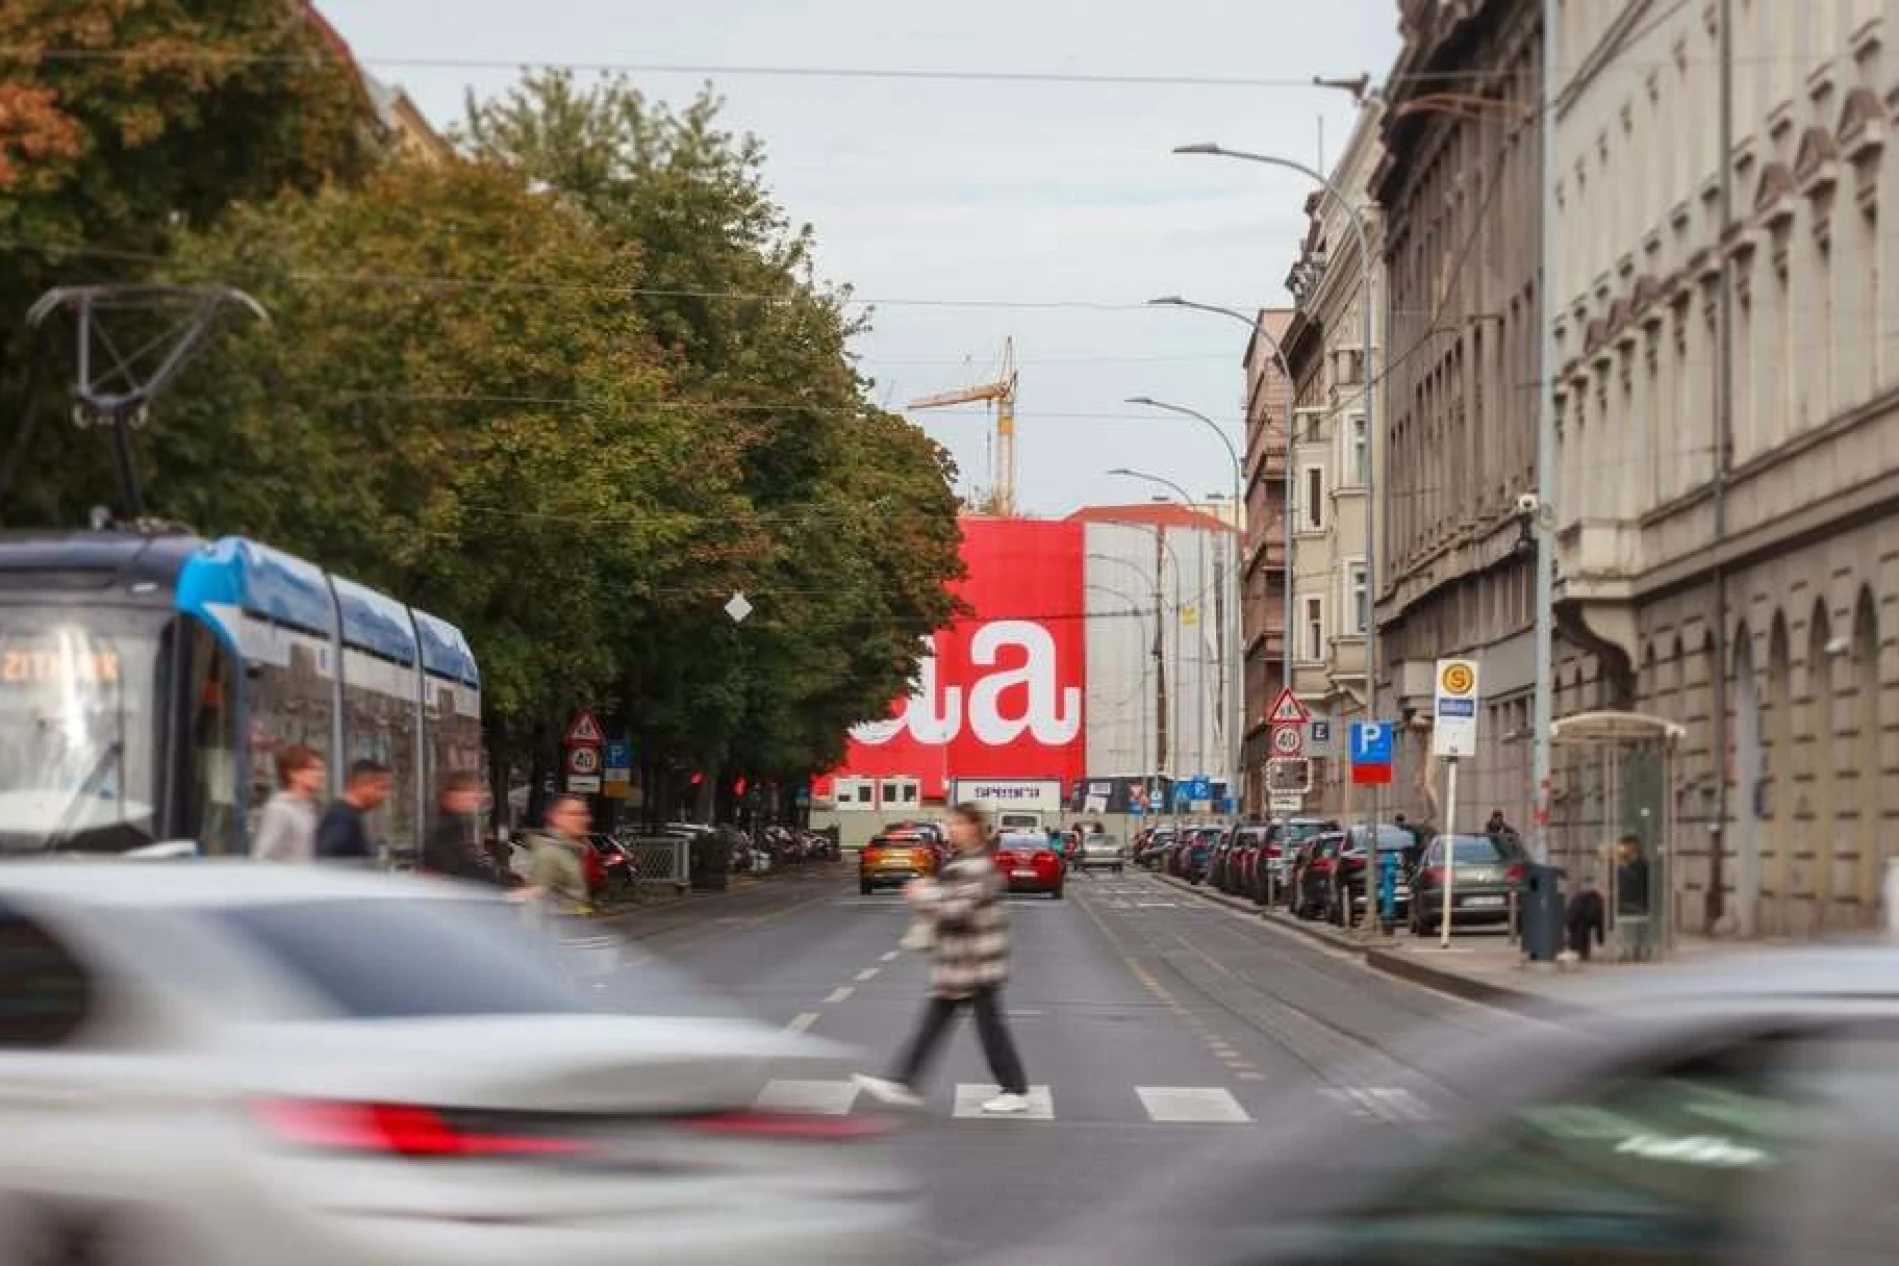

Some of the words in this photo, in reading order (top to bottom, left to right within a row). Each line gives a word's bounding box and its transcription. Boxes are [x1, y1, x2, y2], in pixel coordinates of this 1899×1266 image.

[1315, 724, 1326, 738] E
[1280, 733, 1296, 746] 40
[1360, 724, 1382, 754] P
[575, 751, 593, 767] 40
